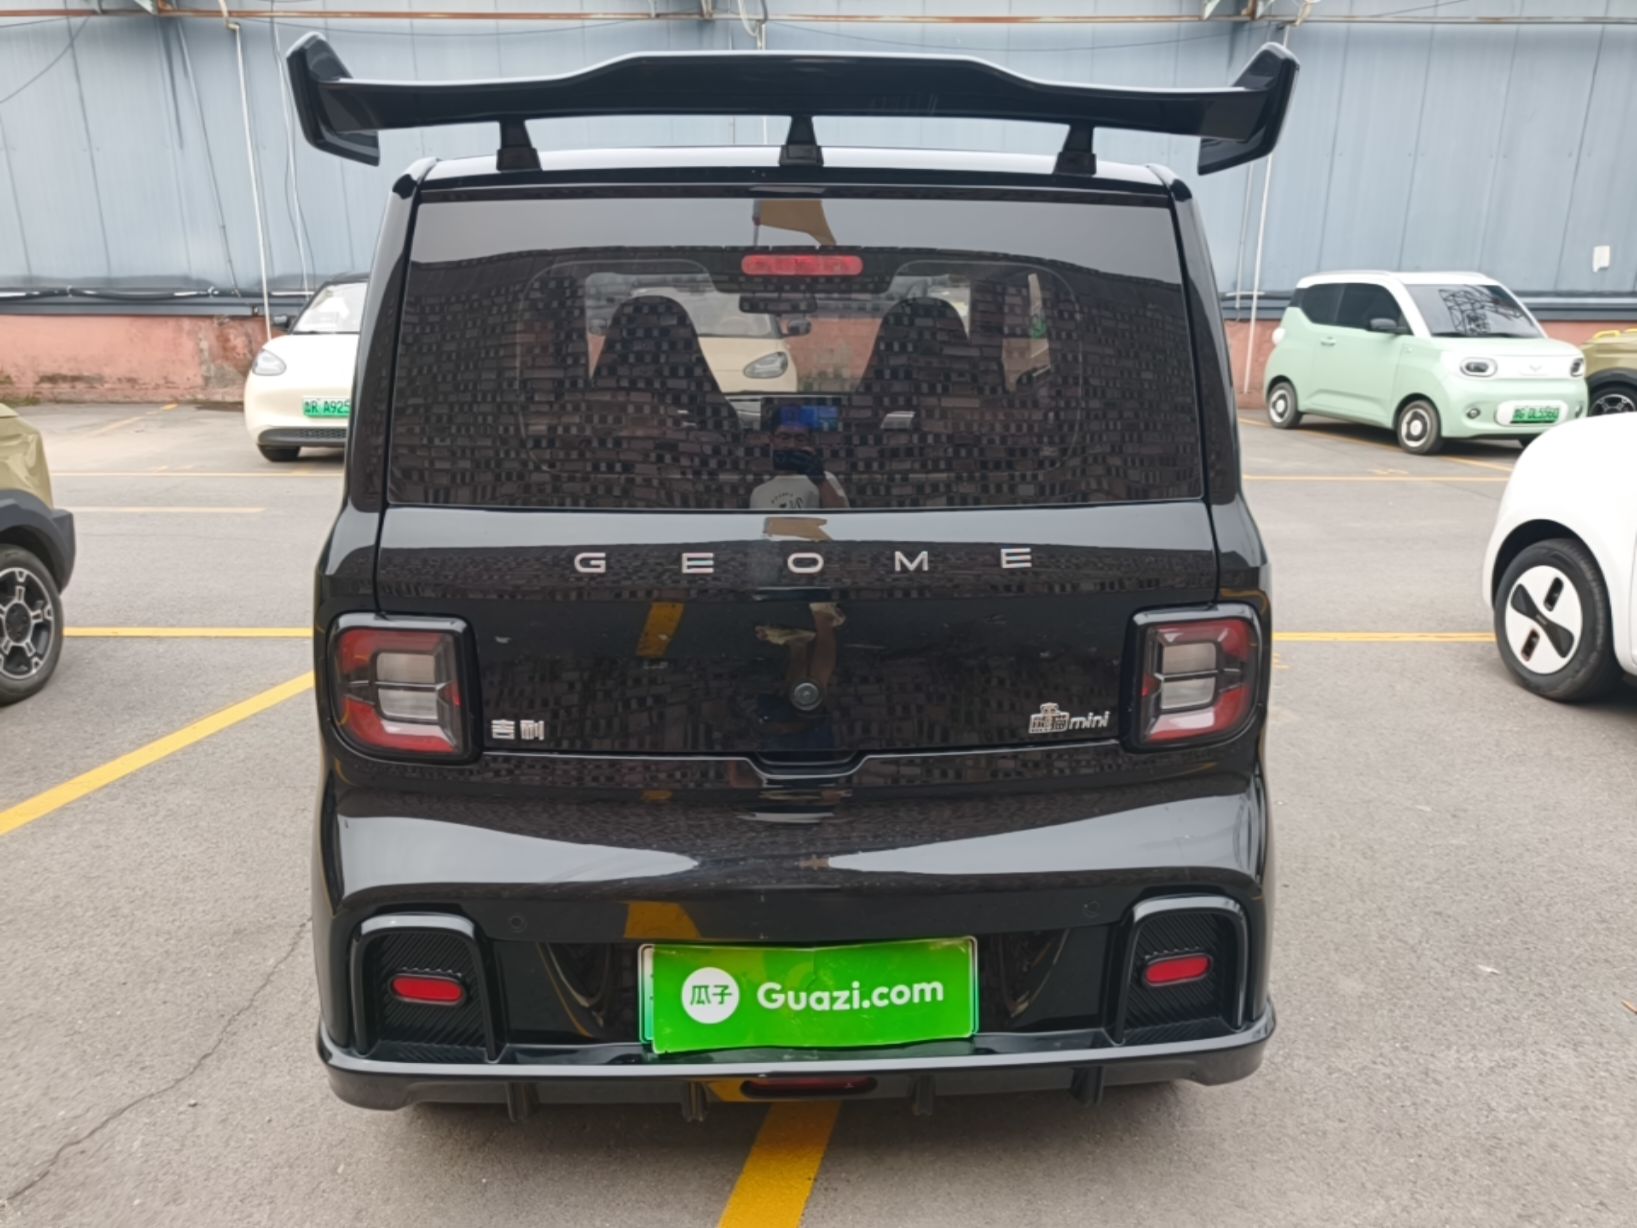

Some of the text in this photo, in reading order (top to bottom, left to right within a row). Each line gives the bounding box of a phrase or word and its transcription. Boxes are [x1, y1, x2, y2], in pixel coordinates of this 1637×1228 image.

[574, 548, 1032, 574] GEOME
[690, 980, 944, 1011] 瓜子 Guazi.com
